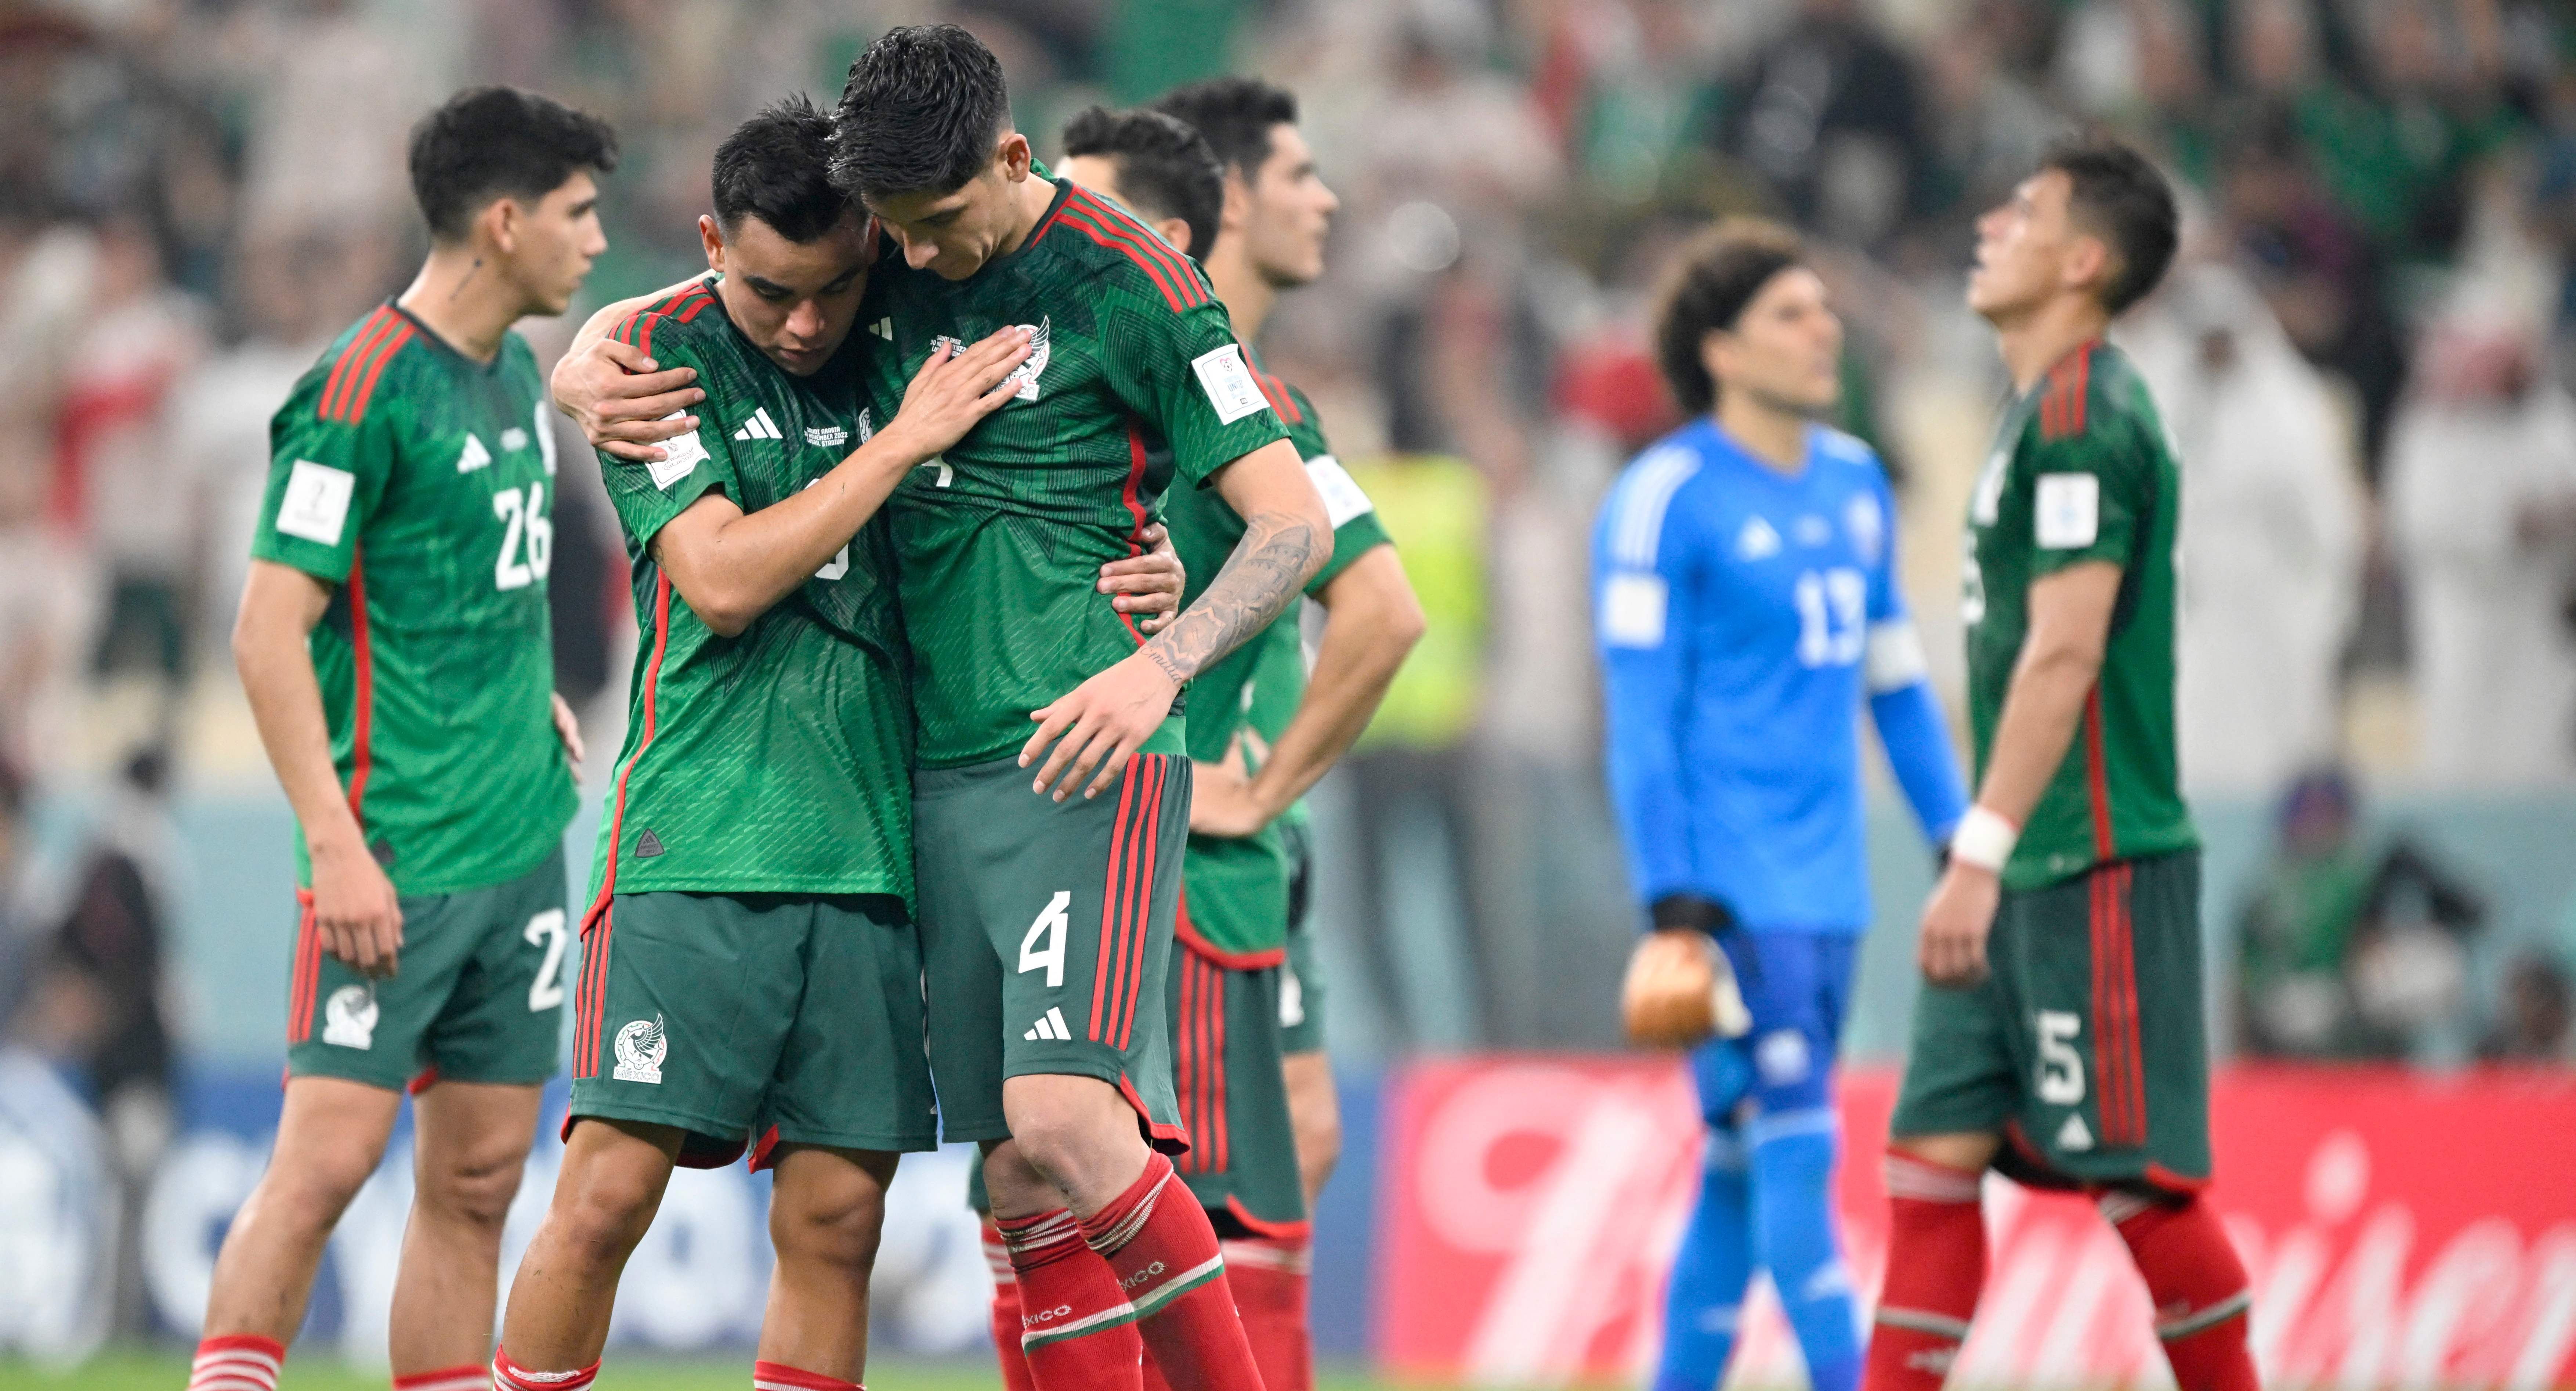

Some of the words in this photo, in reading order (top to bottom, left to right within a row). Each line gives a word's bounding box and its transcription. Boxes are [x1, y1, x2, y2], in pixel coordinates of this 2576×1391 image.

[807, 427, 820, 435] SAUDI
[821, 426, 840, 434] ARABIA
[821, 438, 844, 447] STADIUM
[670, 452, 686, 461] WORLD
[493, 481, 552, 590] 26
[1018, 891, 1070, 987] 4
[524, 907, 569, 1012] 2
[2036, 1009, 2085, 1104] 5
[615, 1067, 659, 1081] MÉXICO
[1116, 1261, 1165, 1292] XICO
[1022, 1305, 1072, 1329] XICO
